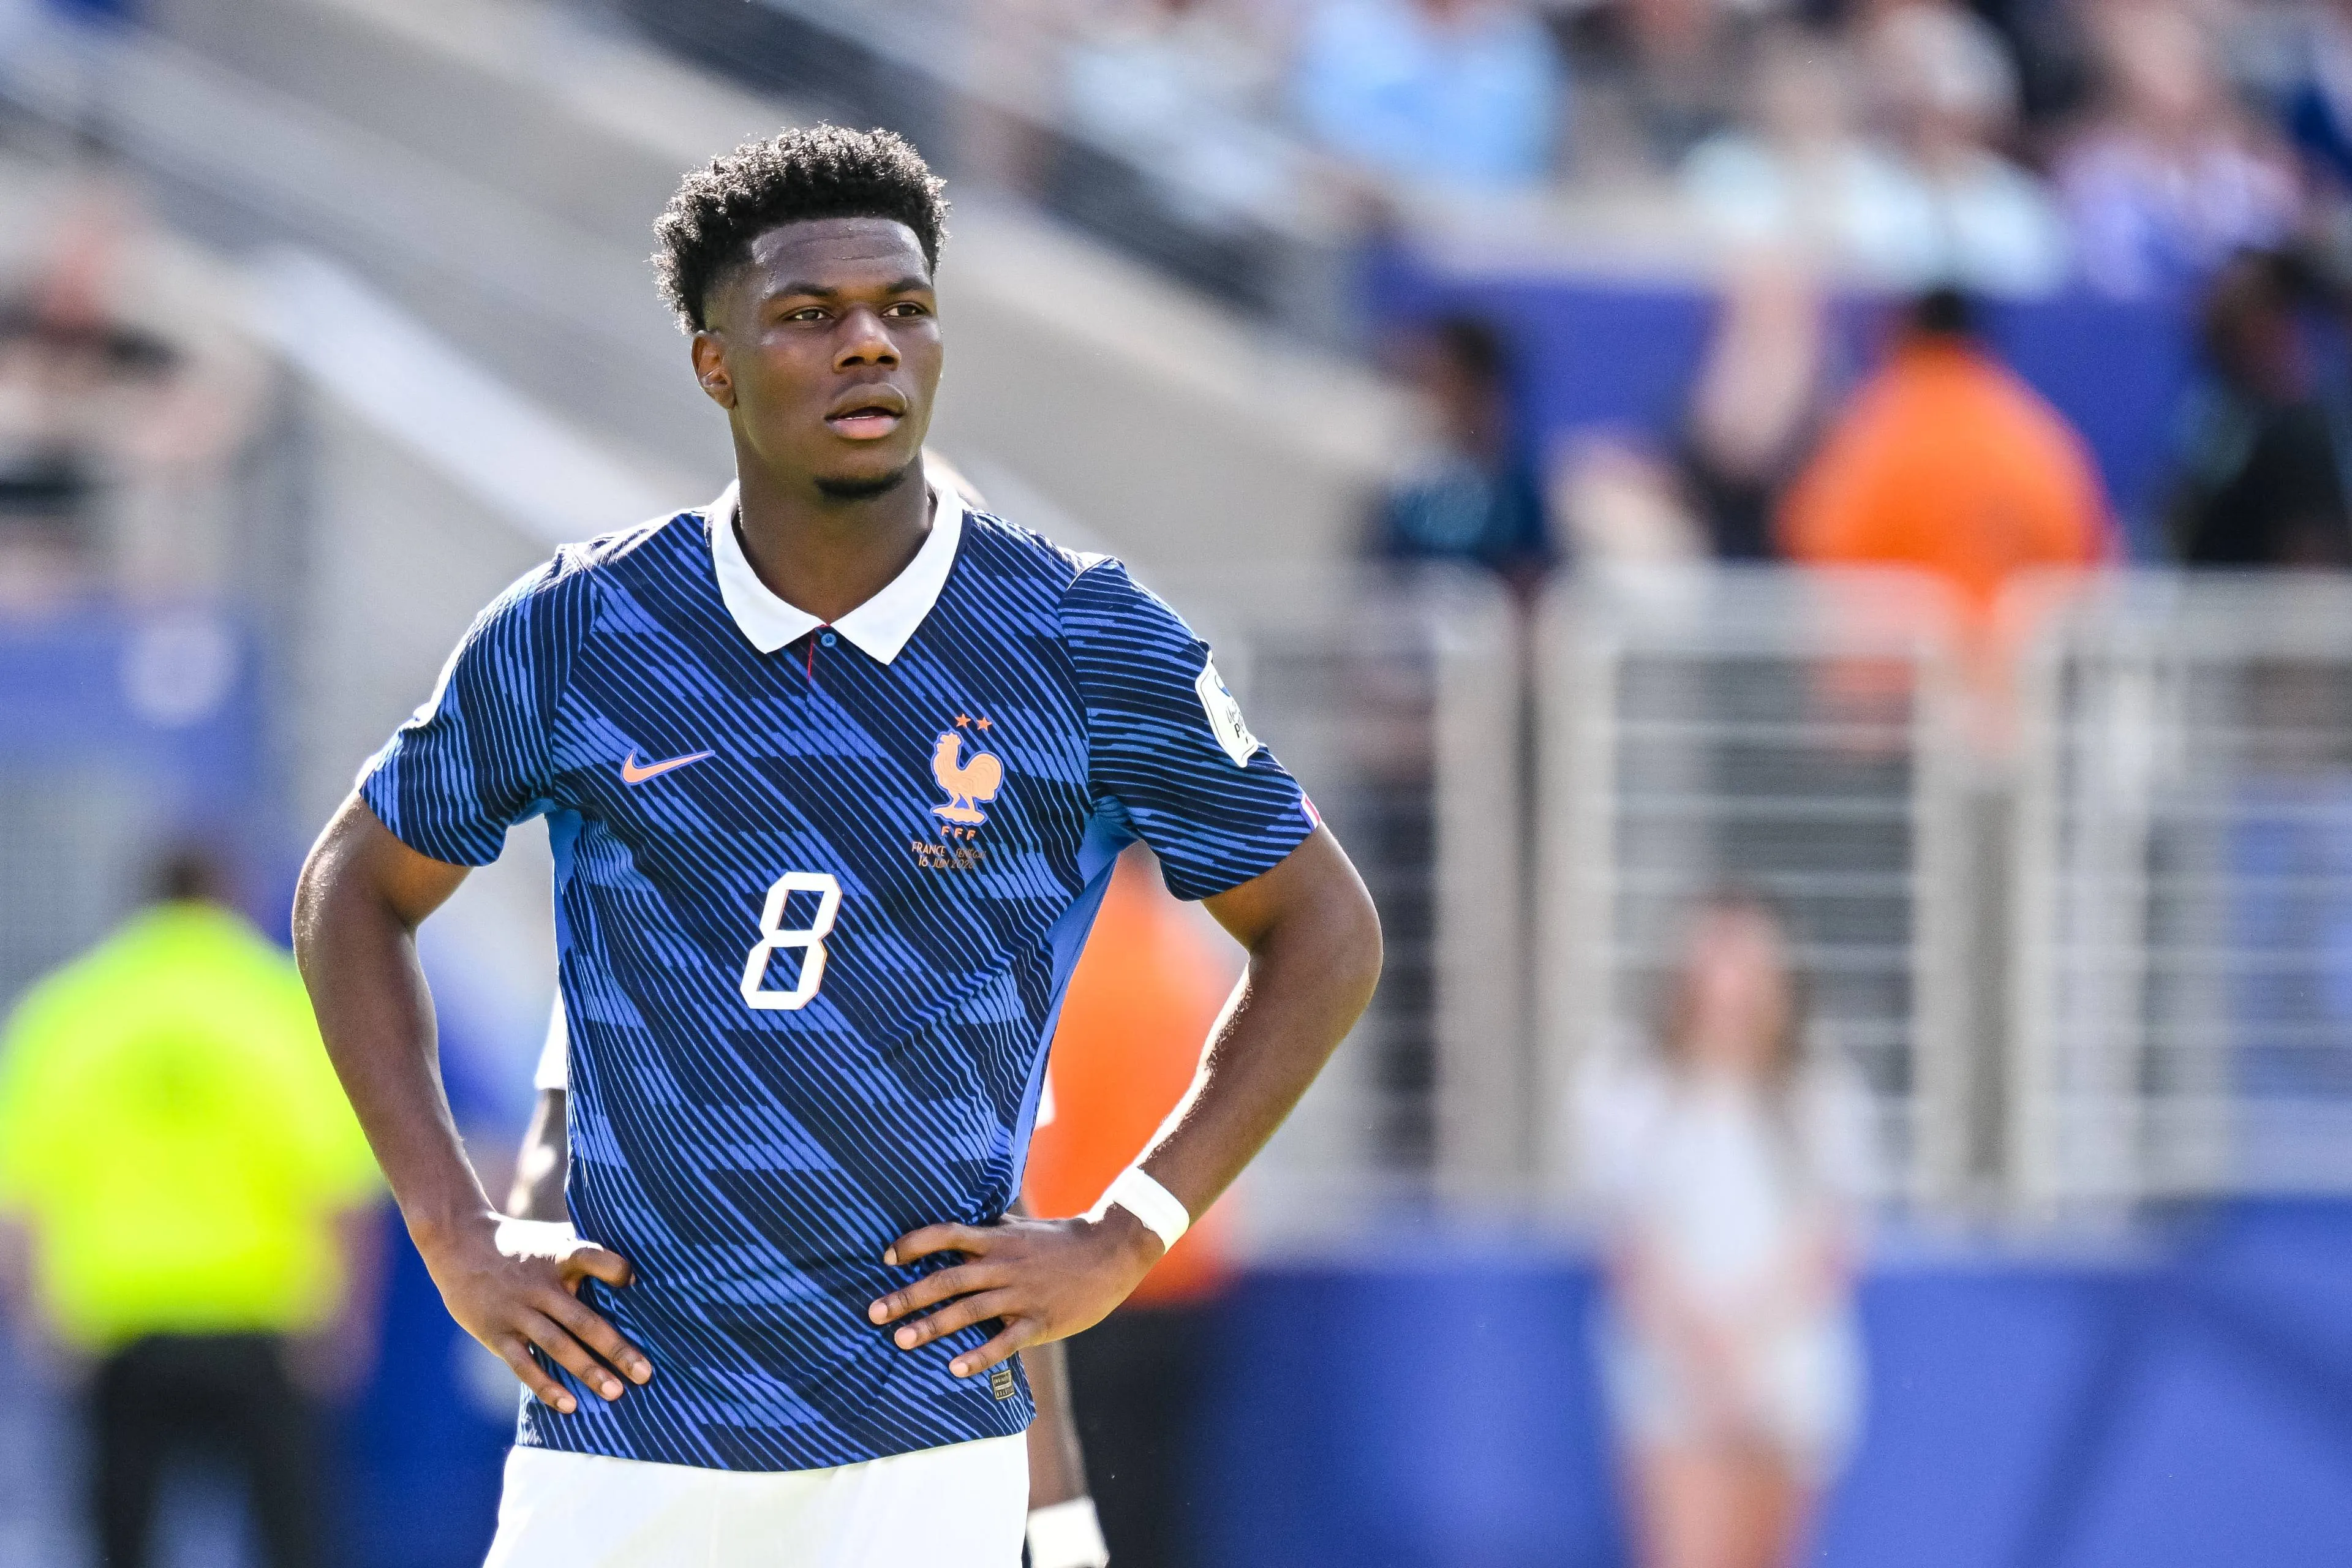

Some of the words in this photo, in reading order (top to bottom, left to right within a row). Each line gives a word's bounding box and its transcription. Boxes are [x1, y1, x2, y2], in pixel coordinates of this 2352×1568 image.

[912, 841, 946, 856] FRANCE
[919, 855, 929, 867] 16
[740, 872, 843, 1010] 8
